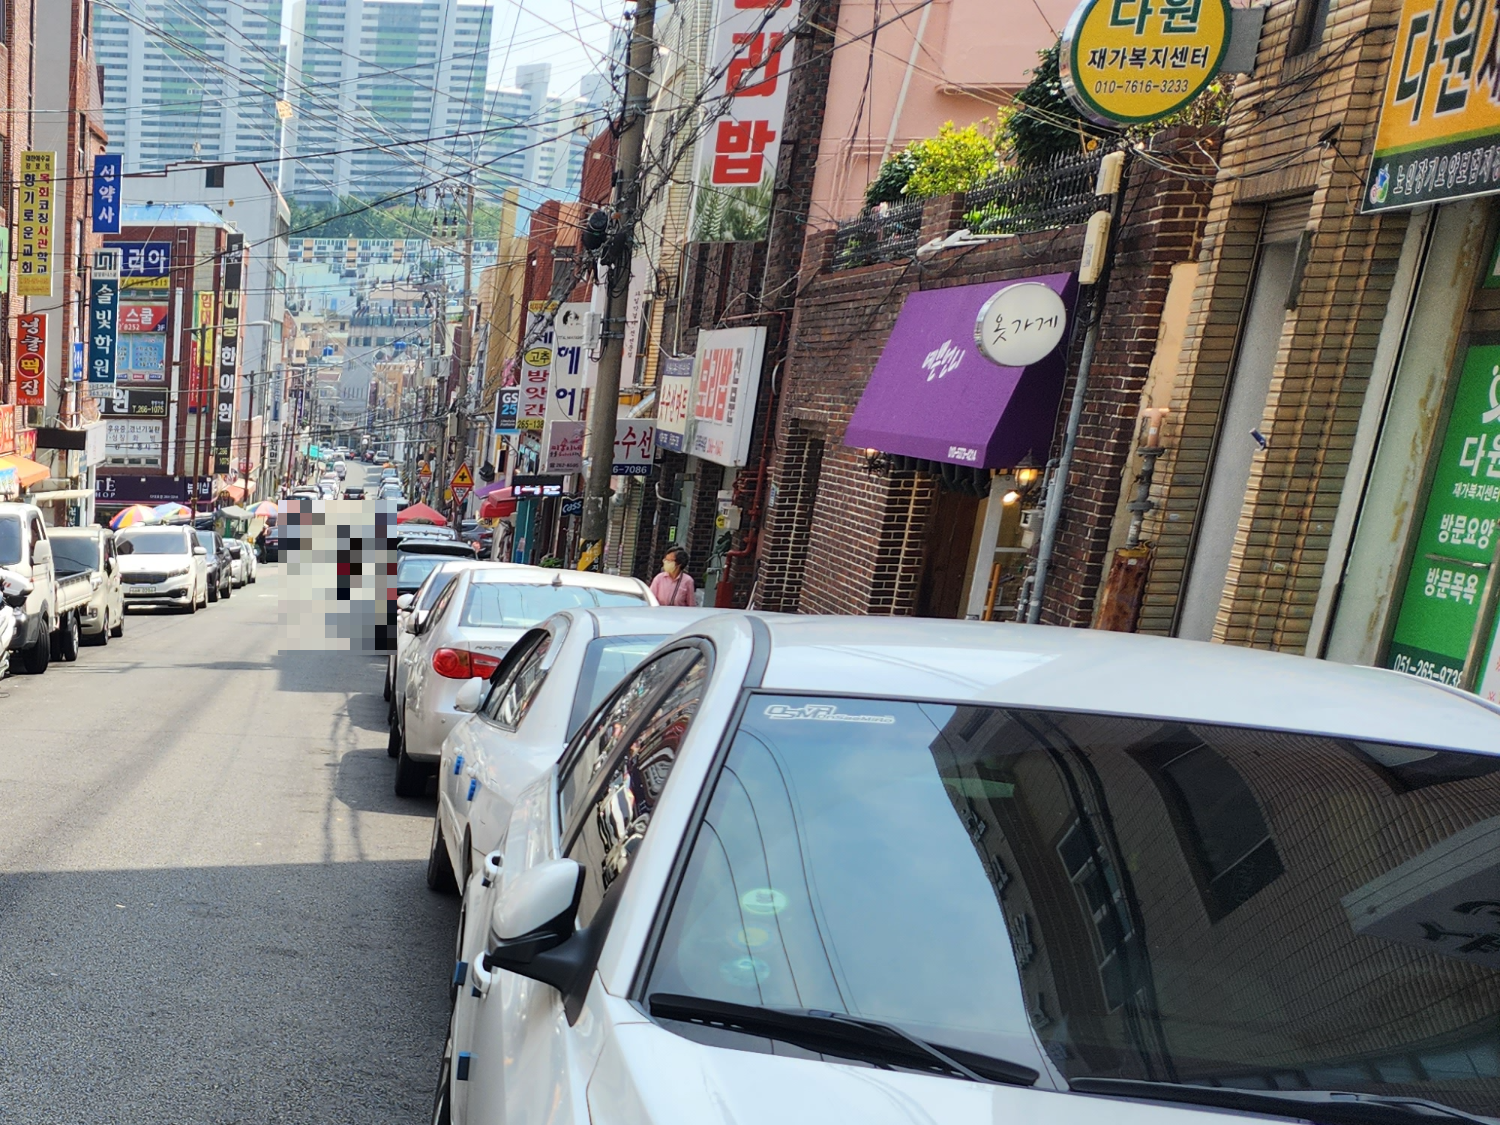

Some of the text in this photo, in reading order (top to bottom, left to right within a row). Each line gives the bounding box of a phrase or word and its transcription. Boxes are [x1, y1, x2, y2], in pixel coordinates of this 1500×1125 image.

[1109, 0, 1201, 35] 다원
[1087, 46, 1211, 70] 재가복지센터
[712, 0, 793, 184] 리밥
[1094, 79, 1189, 94] 010-7616-3233
[22, 173, 35, 274] 향기로운교회
[120, 248, 167, 274] 리아
[126, 308, 153, 325] 스쿨
[993, 313, 1059, 345] 옷가게
[501, 404, 517, 415] 25
[502, 392, 518, 403] GS
[525, 370, 550, 417] 방앗간
[613, 426, 653, 459] 수선
[1452, 482, 1500, 502] 재가복지센터
[1438, 513, 1495, 549] 방문요양
[1424, 567, 1479, 605] 방문목욕
